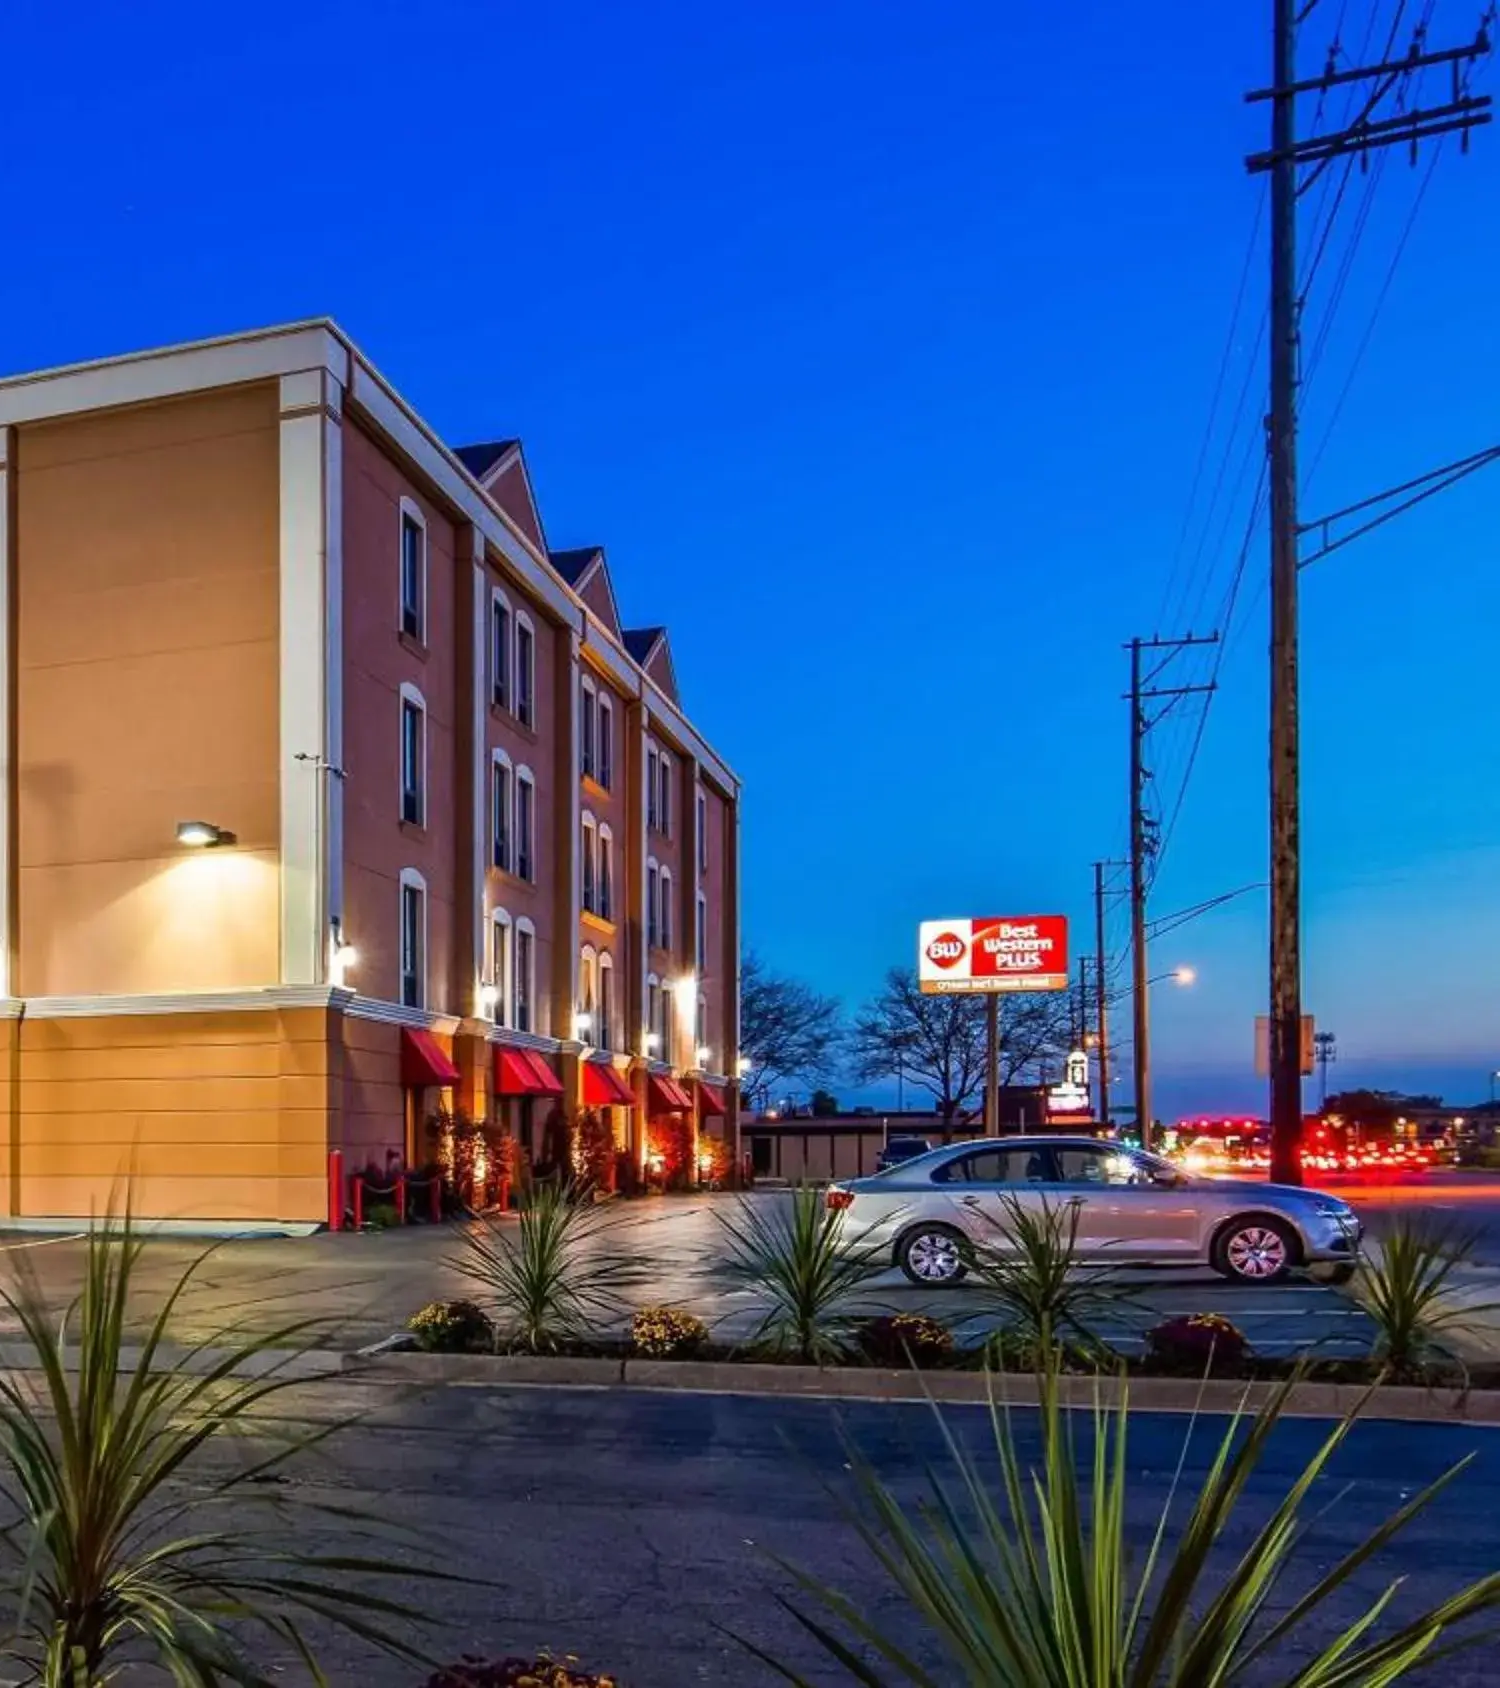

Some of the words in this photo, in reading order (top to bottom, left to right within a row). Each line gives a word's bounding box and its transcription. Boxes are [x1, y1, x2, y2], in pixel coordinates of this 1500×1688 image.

[1000, 924, 1038, 939] Best
[930, 943, 961, 959] BW
[984, 939, 1052, 953] Western
[996, 952, 1041, 967] PLUS
